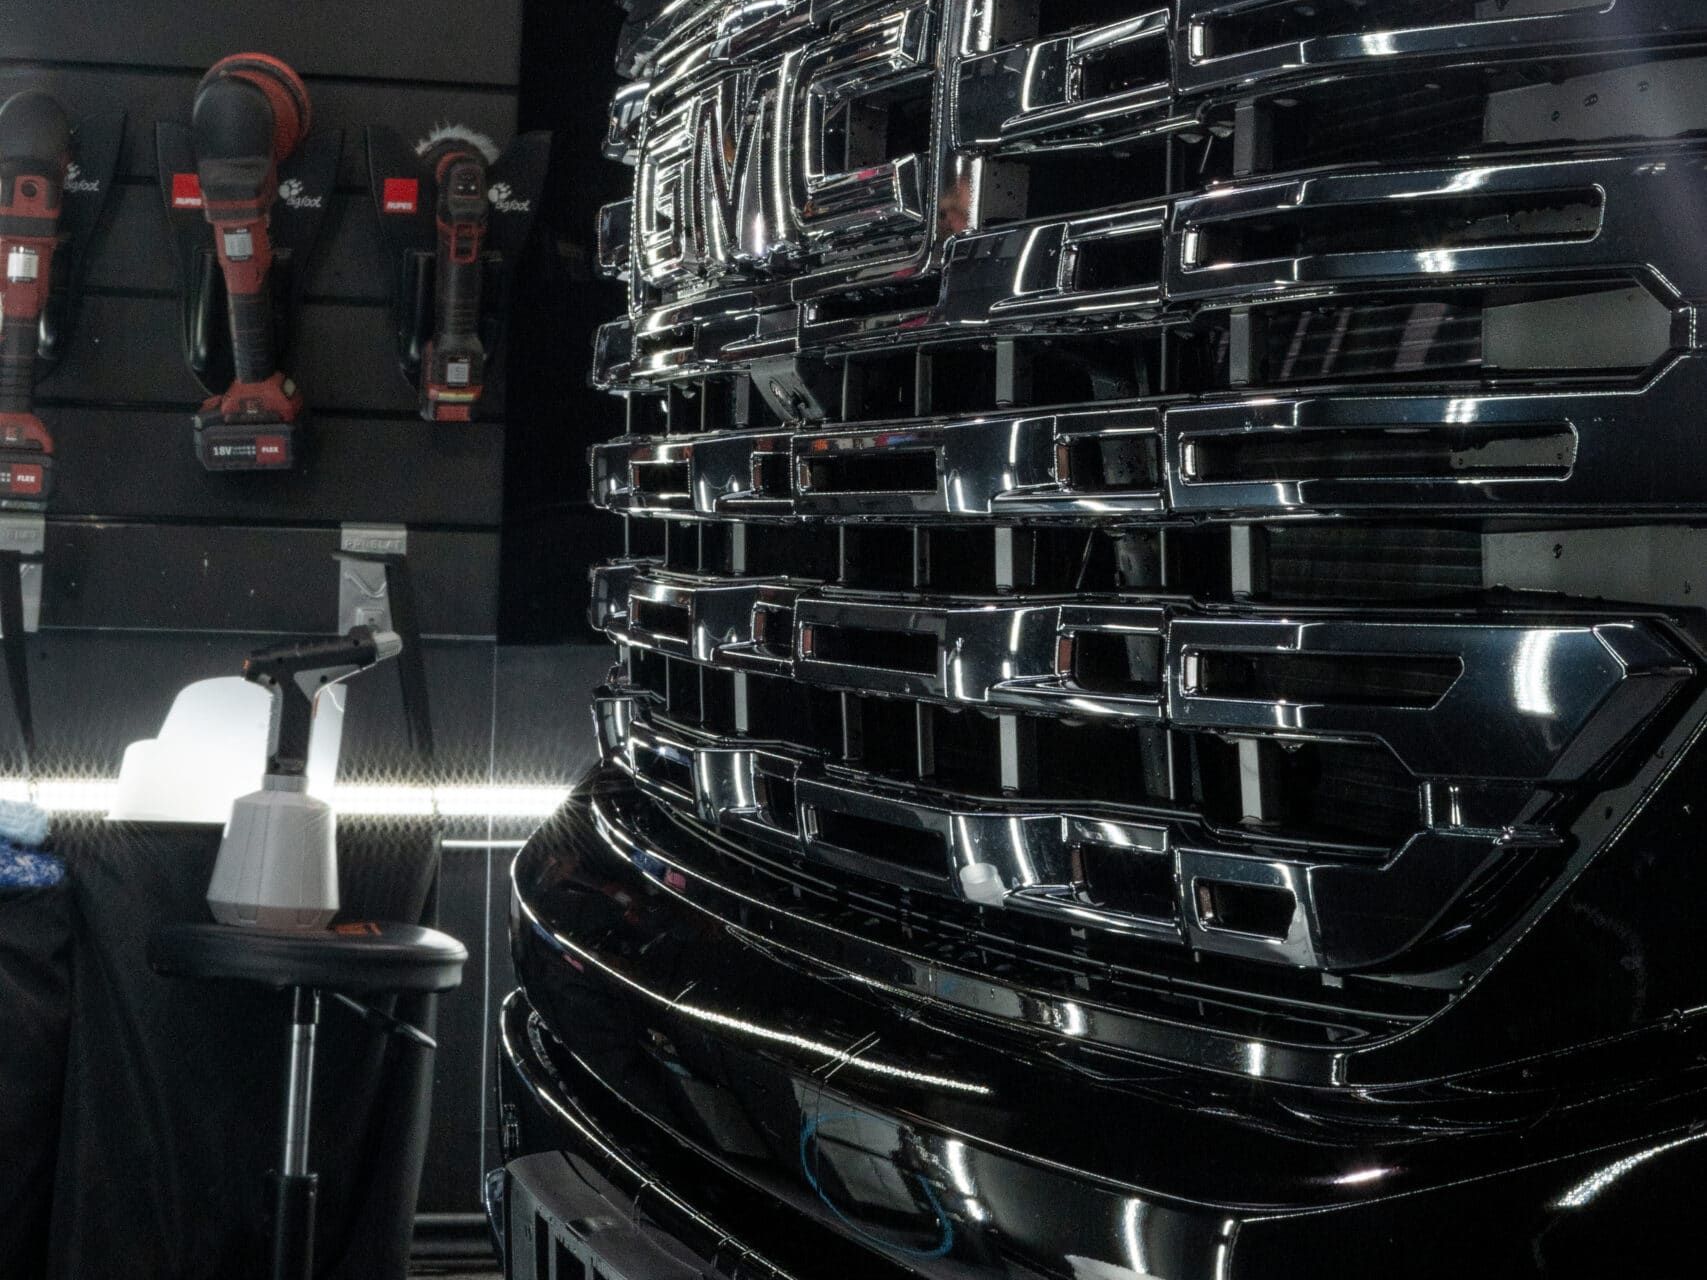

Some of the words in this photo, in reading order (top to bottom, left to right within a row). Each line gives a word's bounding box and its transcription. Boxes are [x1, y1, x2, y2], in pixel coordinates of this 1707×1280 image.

[638, 3, 930, 282] GMC
[213, 445, 232, 457] 18V
[260, 445, 279, 454] FLEX
[16, 474, 36, 483] FLEX
